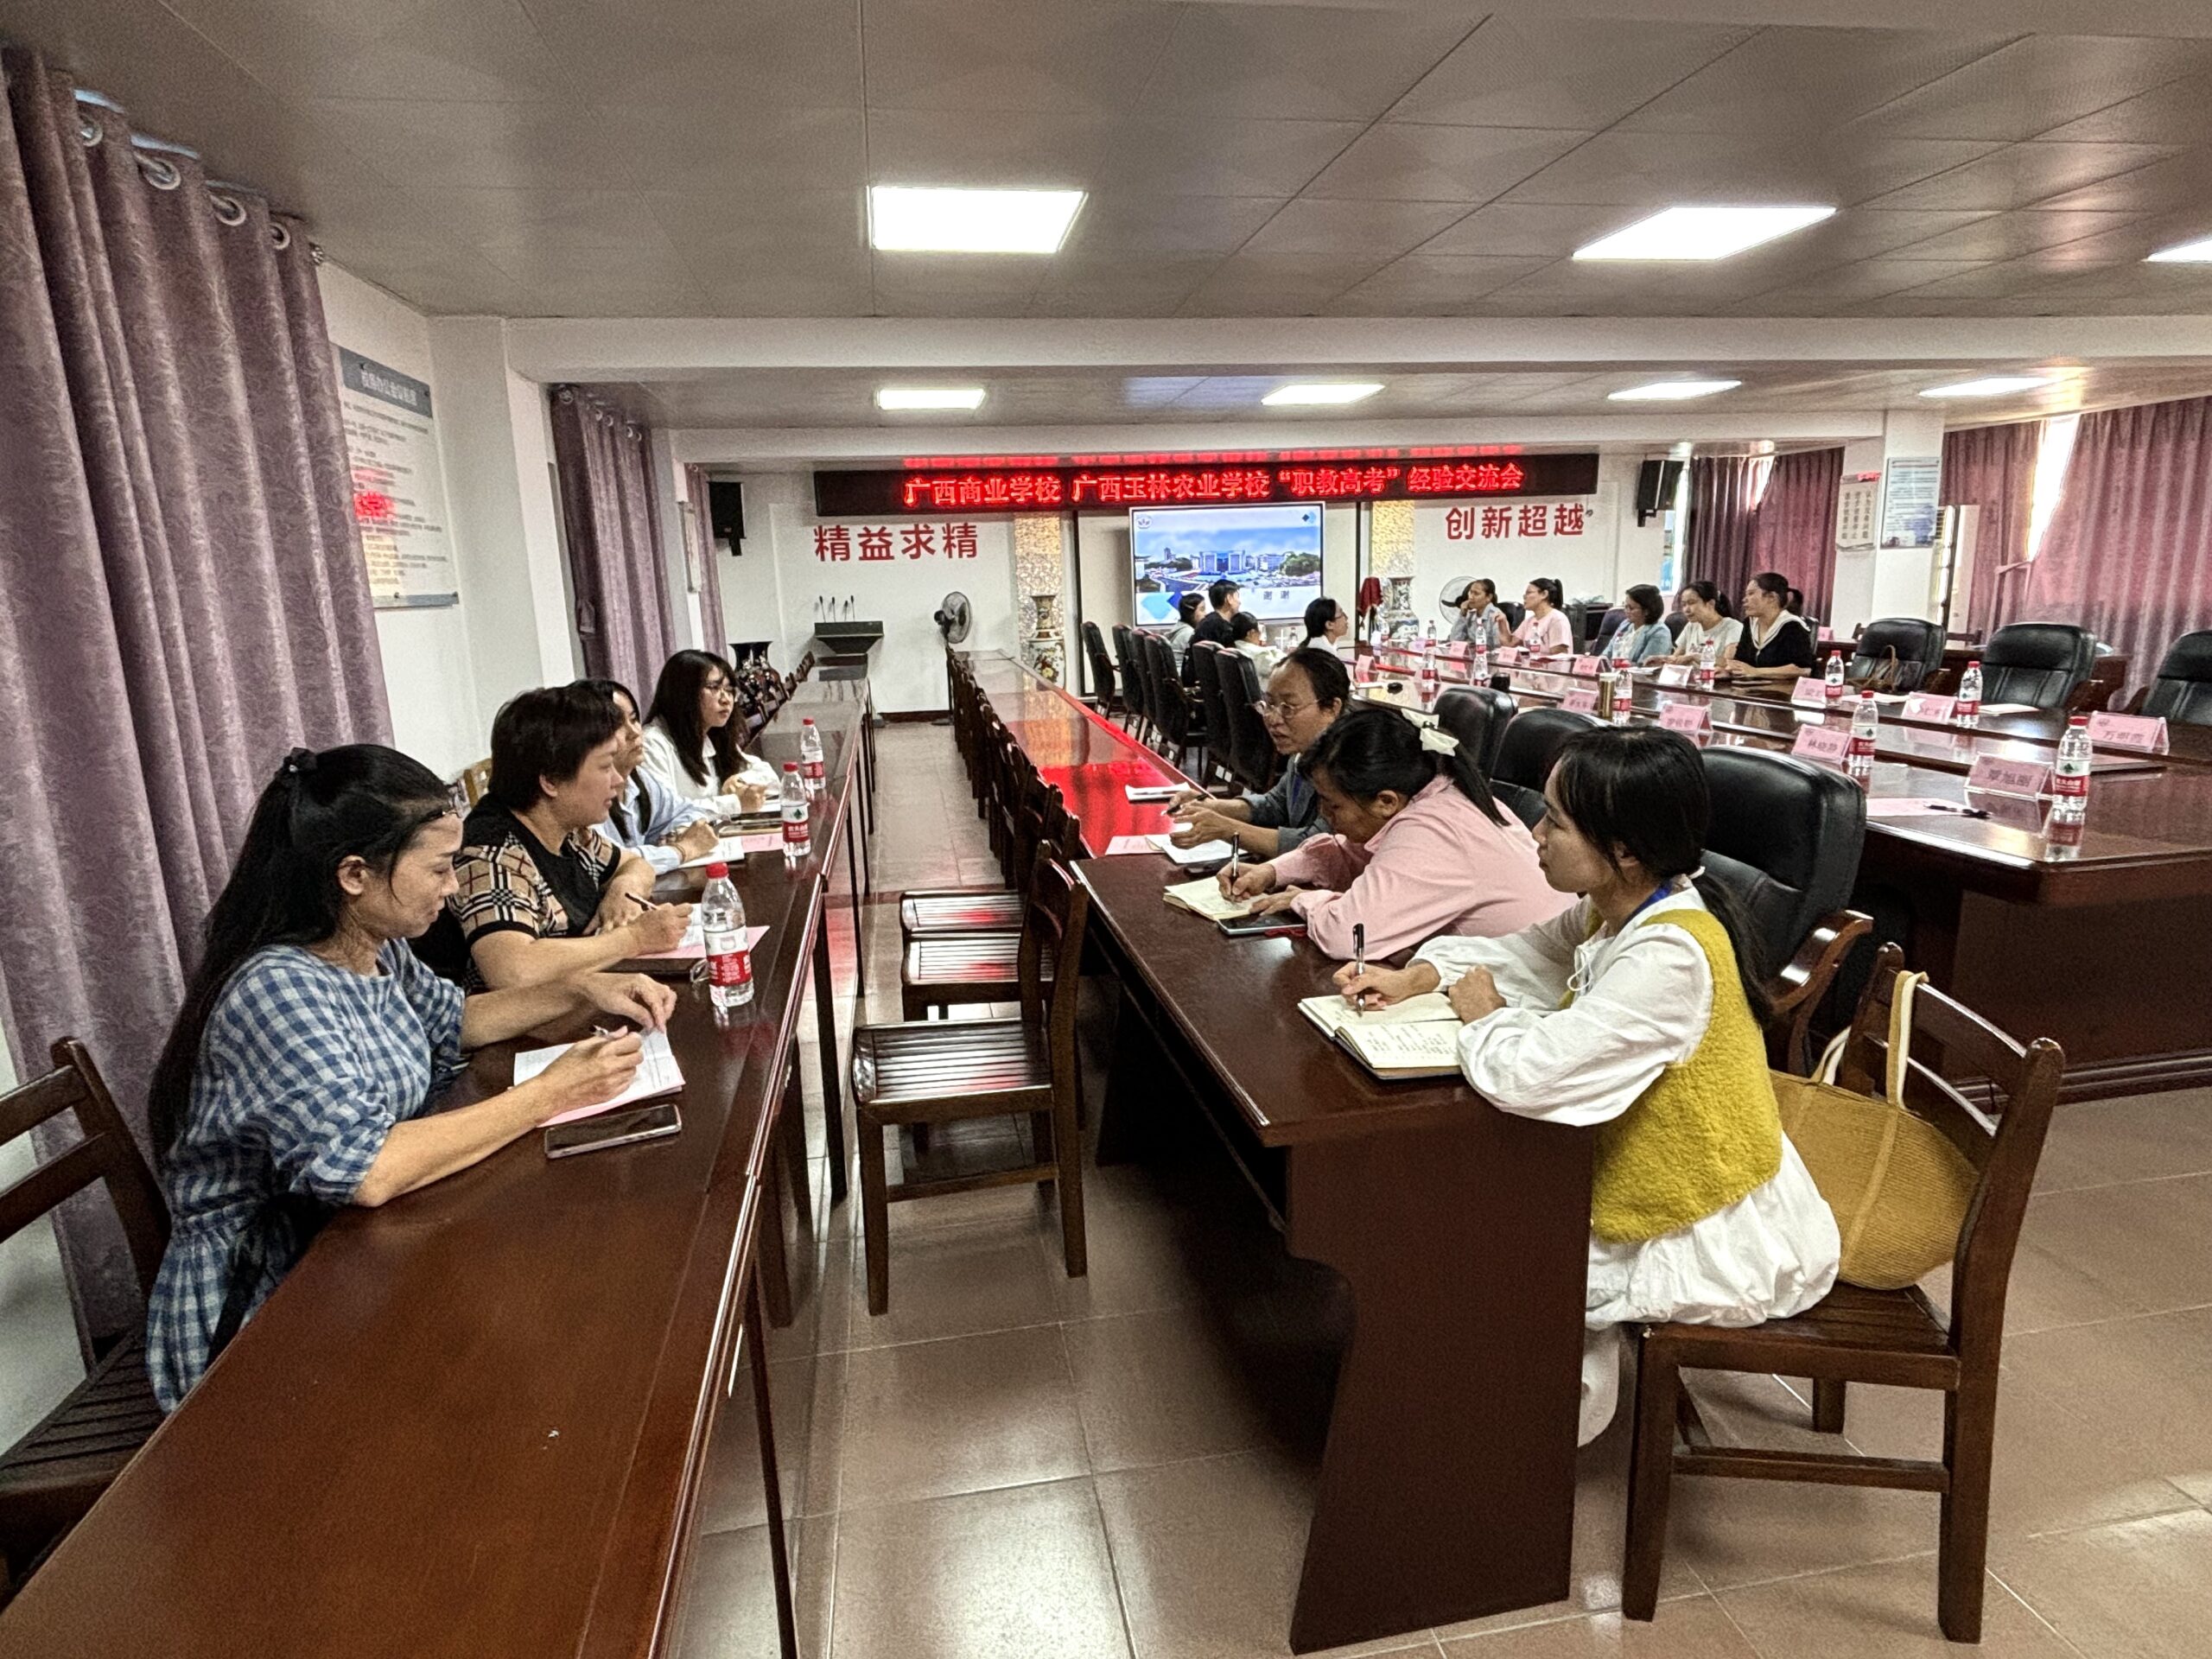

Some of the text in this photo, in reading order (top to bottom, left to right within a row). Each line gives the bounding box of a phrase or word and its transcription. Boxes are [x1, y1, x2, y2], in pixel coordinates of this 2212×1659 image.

[906, 476, 1061, 505] 广西商业学校
[1071, 469, 1270, 503] 广西玉林农业学校
[1408, 462, 1523, 492] 经验交流会
[1445, 502, 1584, 540] 创新超越
[814, 522, 977, 562] 精益求精
